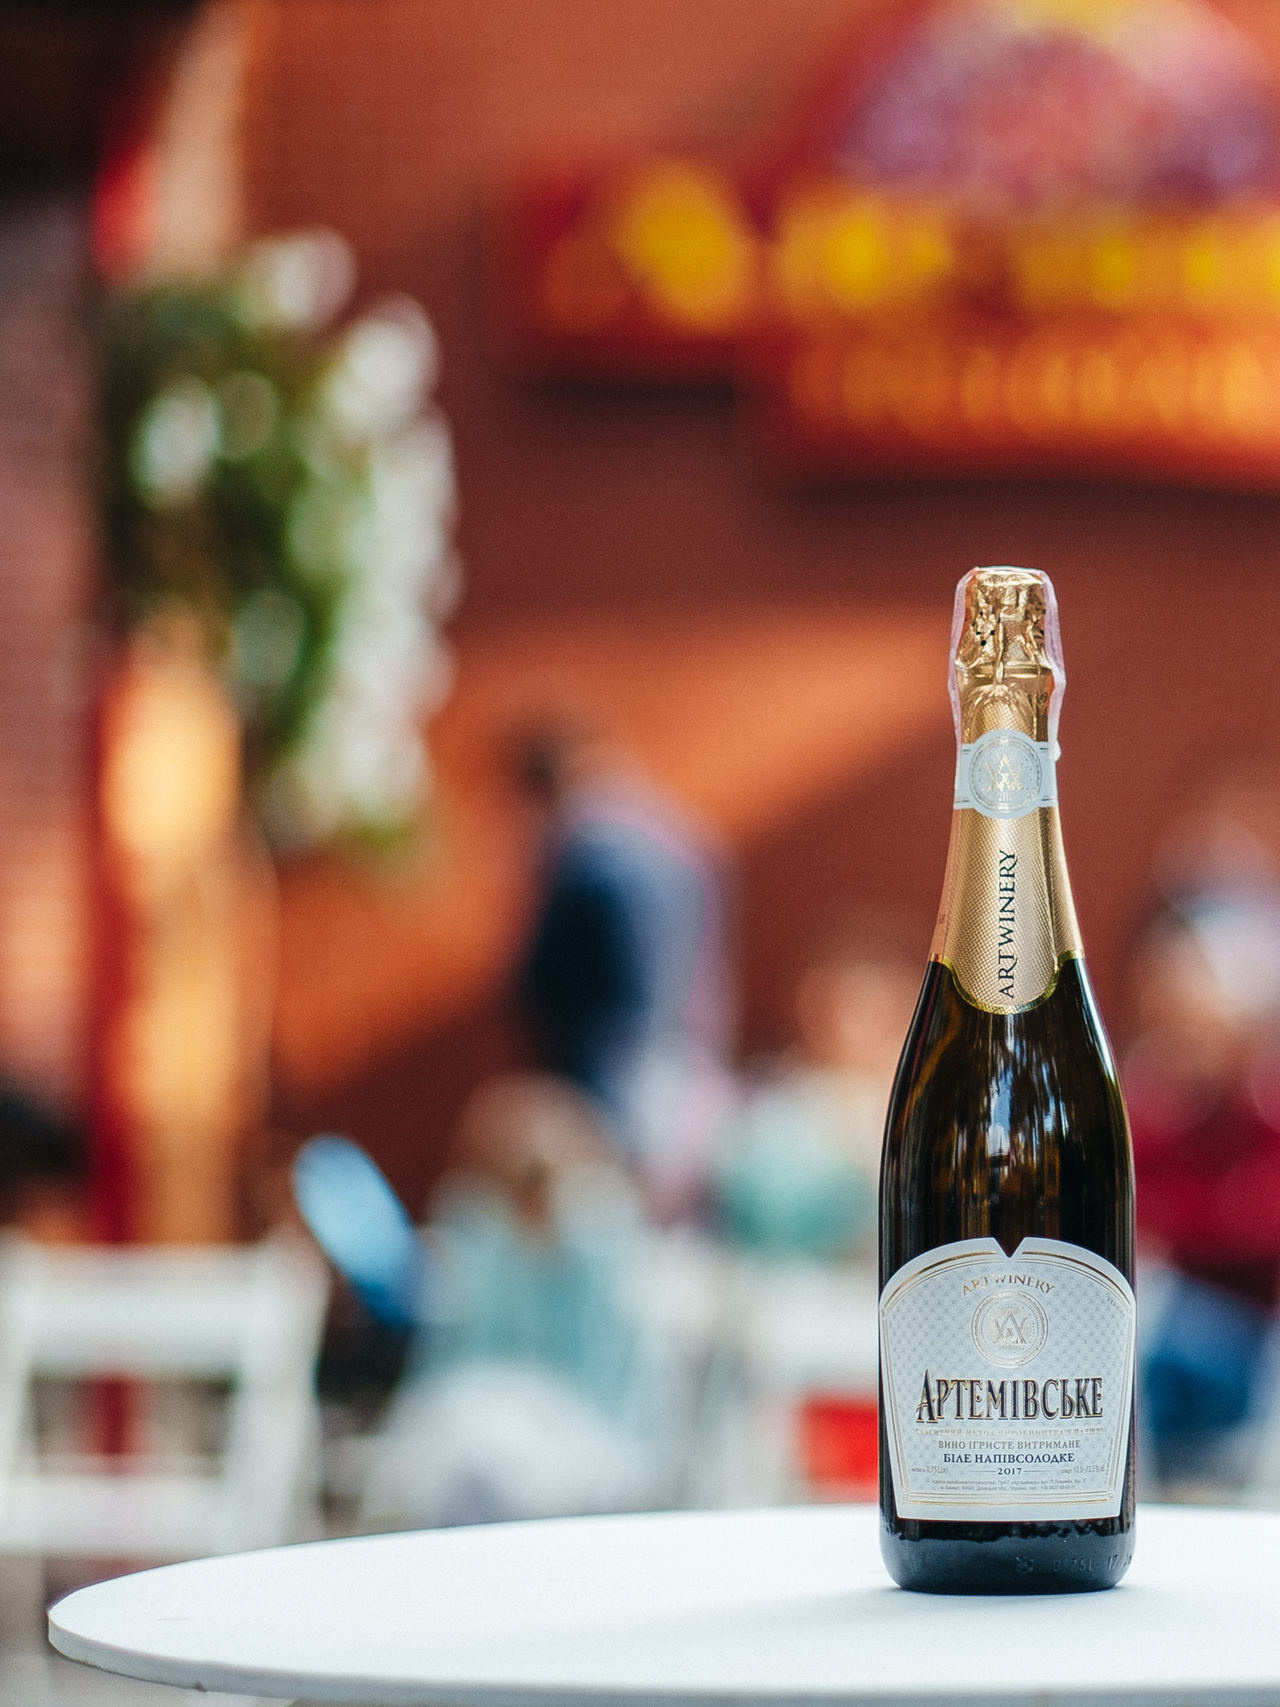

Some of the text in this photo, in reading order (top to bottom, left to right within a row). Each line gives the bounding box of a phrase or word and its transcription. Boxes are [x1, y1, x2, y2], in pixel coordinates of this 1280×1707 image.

[998, 850, 1018, 999] ARTWINERY
[961, 1272, 1056, 1297] ARTWINERY
[915, 1368, 1104, 1423] АРТЕМІВСЬКЕ
[938, 1439, 1081, 1450] ВИНО ІГРИСТЕ ВИТРИМАНЕ
[943, 1452, 1076, 1464] БІЛЕ НАПІВСОЛОДКЕ
[997, 1467, 1022, 1475] 2017
